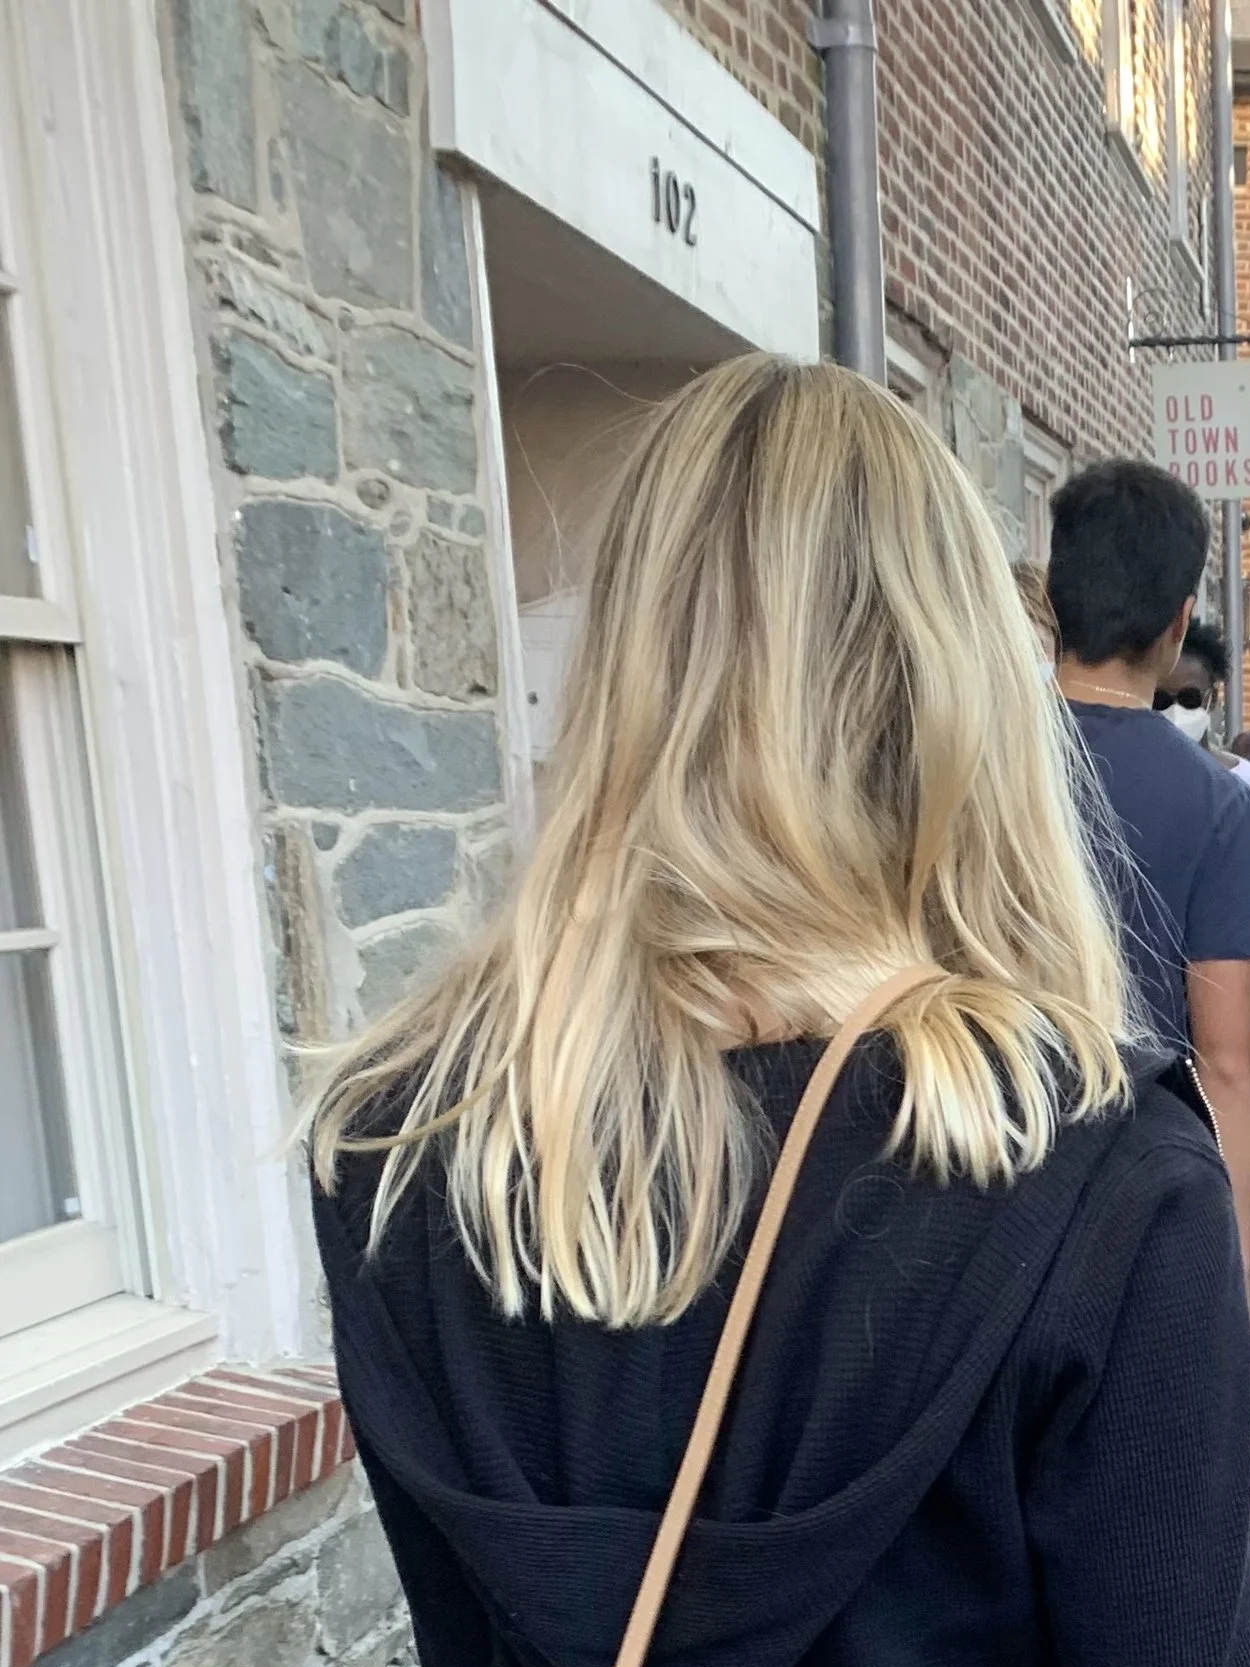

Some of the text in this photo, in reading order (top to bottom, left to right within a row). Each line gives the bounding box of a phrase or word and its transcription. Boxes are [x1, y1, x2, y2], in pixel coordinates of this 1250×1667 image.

[650, 154, 698, 247] 102
[1165, 393, 1213, 423] OLD
[1168, 425, 1239, 455] TOWN
